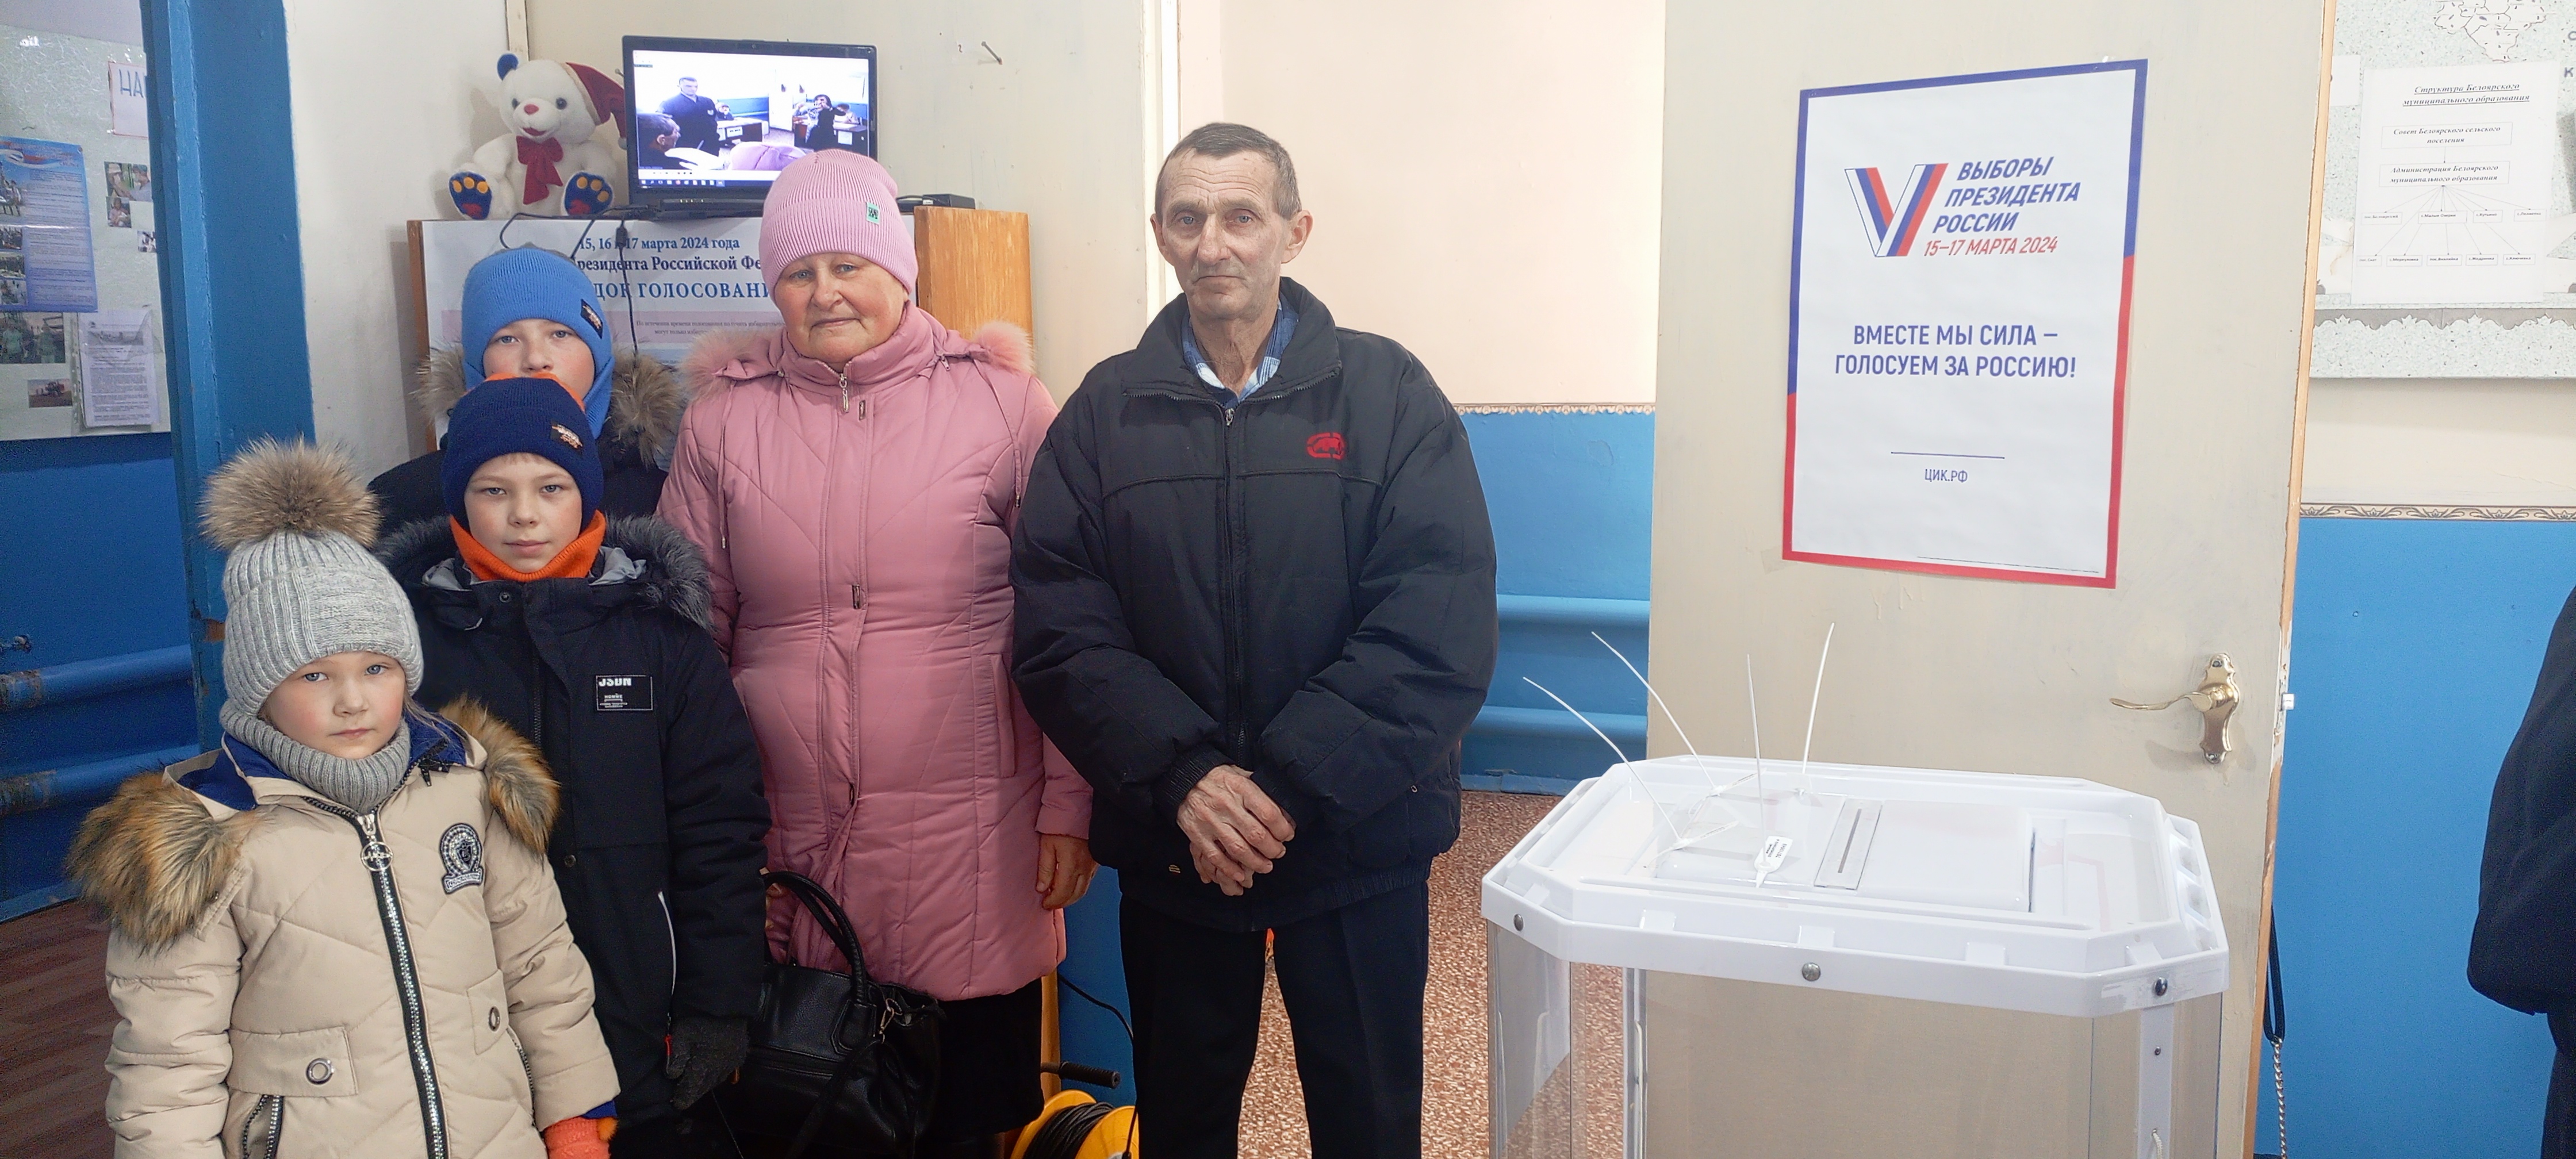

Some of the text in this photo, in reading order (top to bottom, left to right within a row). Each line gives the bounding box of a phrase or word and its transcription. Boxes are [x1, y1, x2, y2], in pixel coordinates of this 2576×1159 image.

[119, 69, 145, 98] НА
[2414, 83, 2520, 94] Структура Белоярского
[2403, 95, 2530, 105] муниципального образования
[1957, 156, 2054, 181] ВЫБОРЫ
[1944, 182, 2081, 208] ПРЕЗИДЕНТА
[1933, 212, 2019, 233] РОССИИ
[599, 238, 611, 249] 16
[626, 237, 638, 249] 17
[641, 238, 677, 252] марта
[681, 237, 708, 249] 2024
[711, 238, 740, 250] года
[1965, 238, 2018, 256] МАРТА
[2019, 236, 2058, 254] 2024
[651, 256, 737, 271] Российской
[1854, 325, 1930, 345] ВМЕСТЕ
[1937, 325, 1972, 345] МЫ
[1980, 325, 2037, 346] СИЛА
[1835, 355, 2076, 378] ГОЛОСУЕМ ЗА РОССИЮ!
[1924, 469, 1968, 483] ЦИК.РФ
